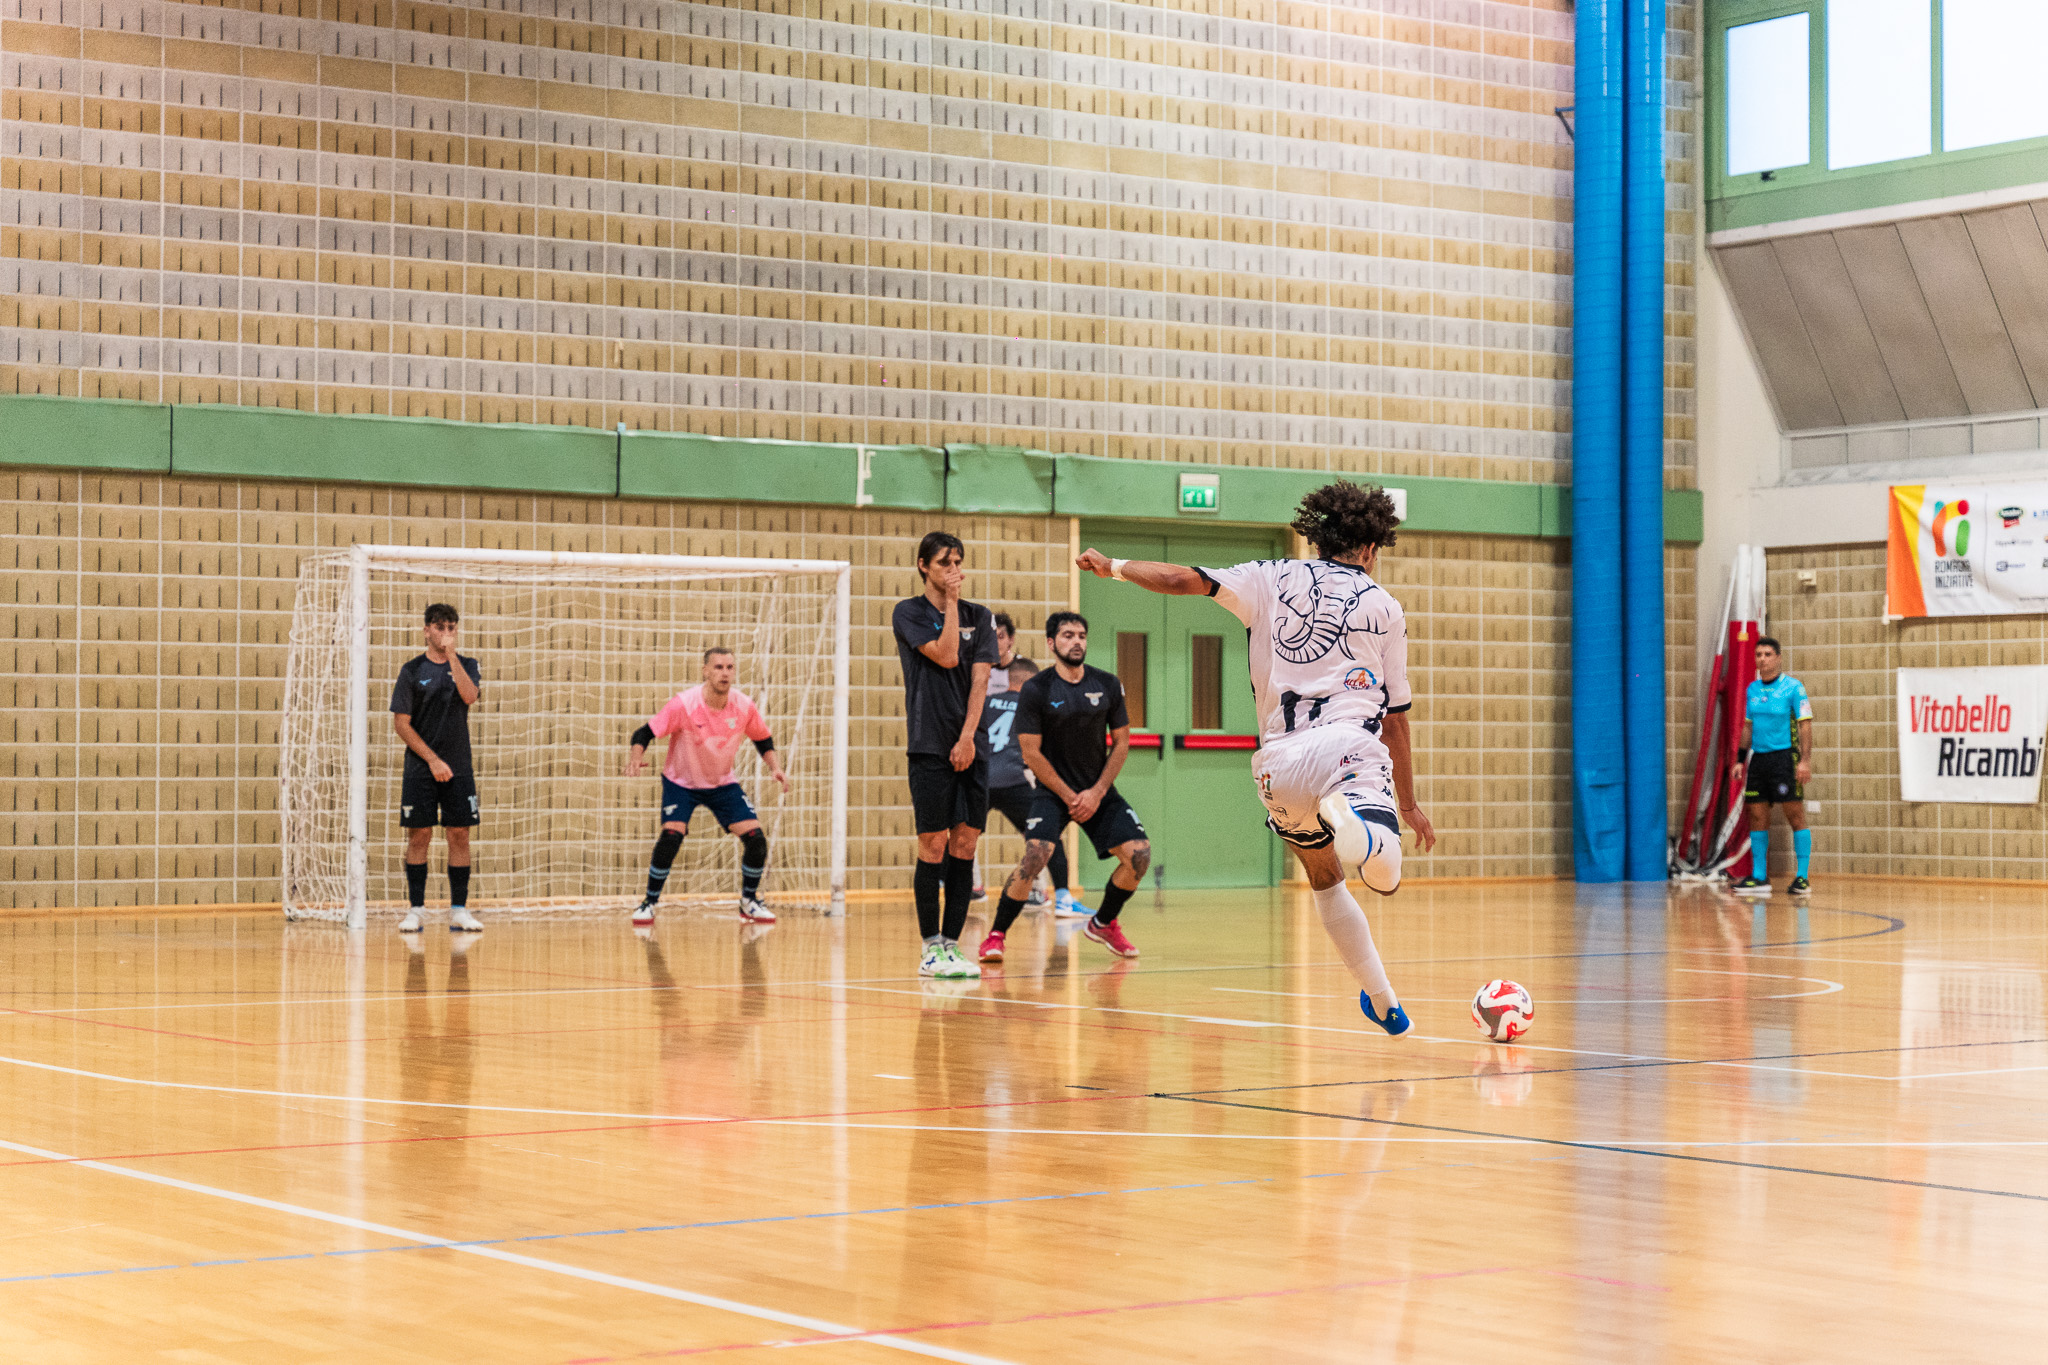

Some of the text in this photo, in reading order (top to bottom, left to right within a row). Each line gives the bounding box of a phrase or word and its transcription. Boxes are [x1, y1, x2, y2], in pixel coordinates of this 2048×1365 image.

[988, 710, 1015, 753] 4
[1910, 694, 2012, 733] Vitobello
[1937, 736, 2043, 777] Ricambi
